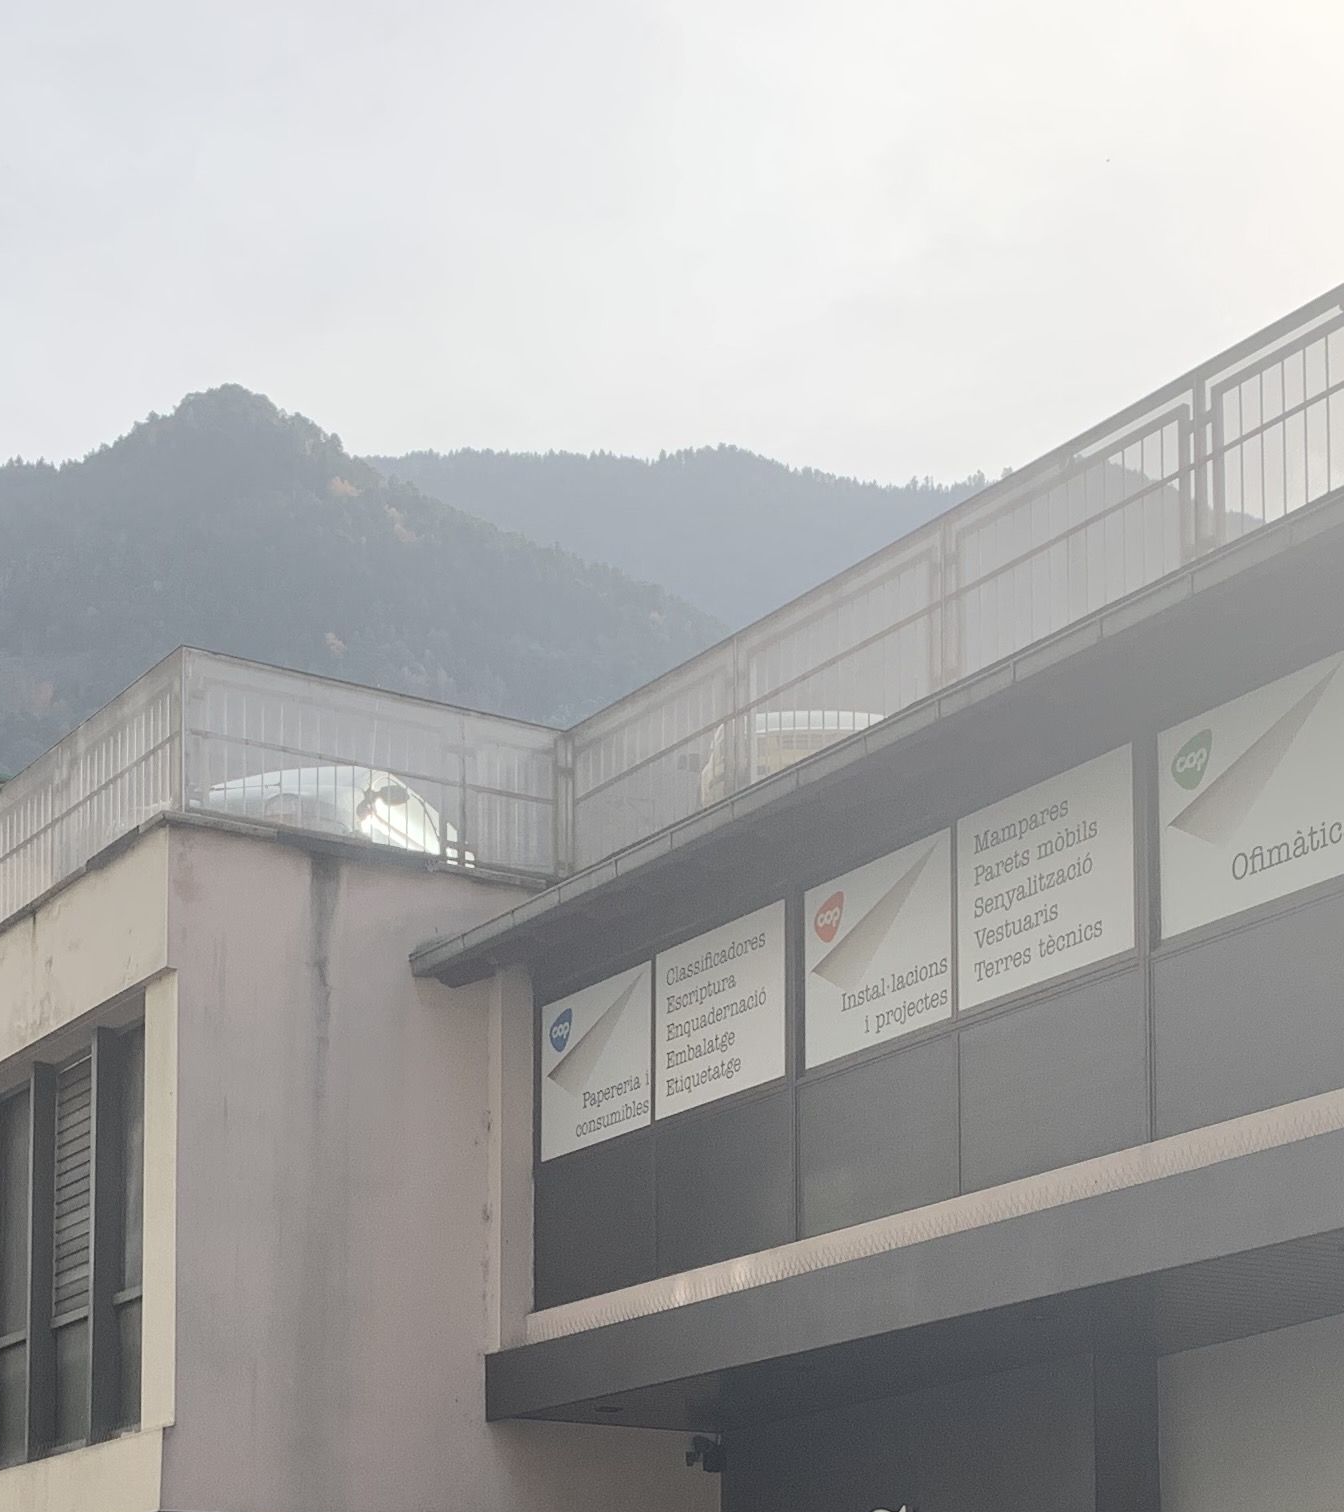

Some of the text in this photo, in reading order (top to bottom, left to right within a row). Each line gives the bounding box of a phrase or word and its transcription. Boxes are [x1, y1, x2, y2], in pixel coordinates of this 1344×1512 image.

[1174, 745, 1209, 774] cop
[973, 799, 1069, 854] Mampares
[974, 820, 1098, 886] Parets mòbils
[974, 852, 1093, 919] Senyalització
[816, 907, 841, 928] cop
[974, 903, 1059, 949] Vestuaris
[666, 932, 767, 986] Classificadores
[974, 920, 1104, 982] Terres tècnics
[666, 974, 737, 1014] Escriptura
[666, 987, 767, 1042] Enquadernació
[864, 989, 948, 1034] i projectes
[666, 1030, 736, 1070] Embalatge
[582, 1076, 641, 1109] Papereria
[666, 1057, 741, 1097] Etiquetatge
[576, 1100, 650, 1137] consumibles
